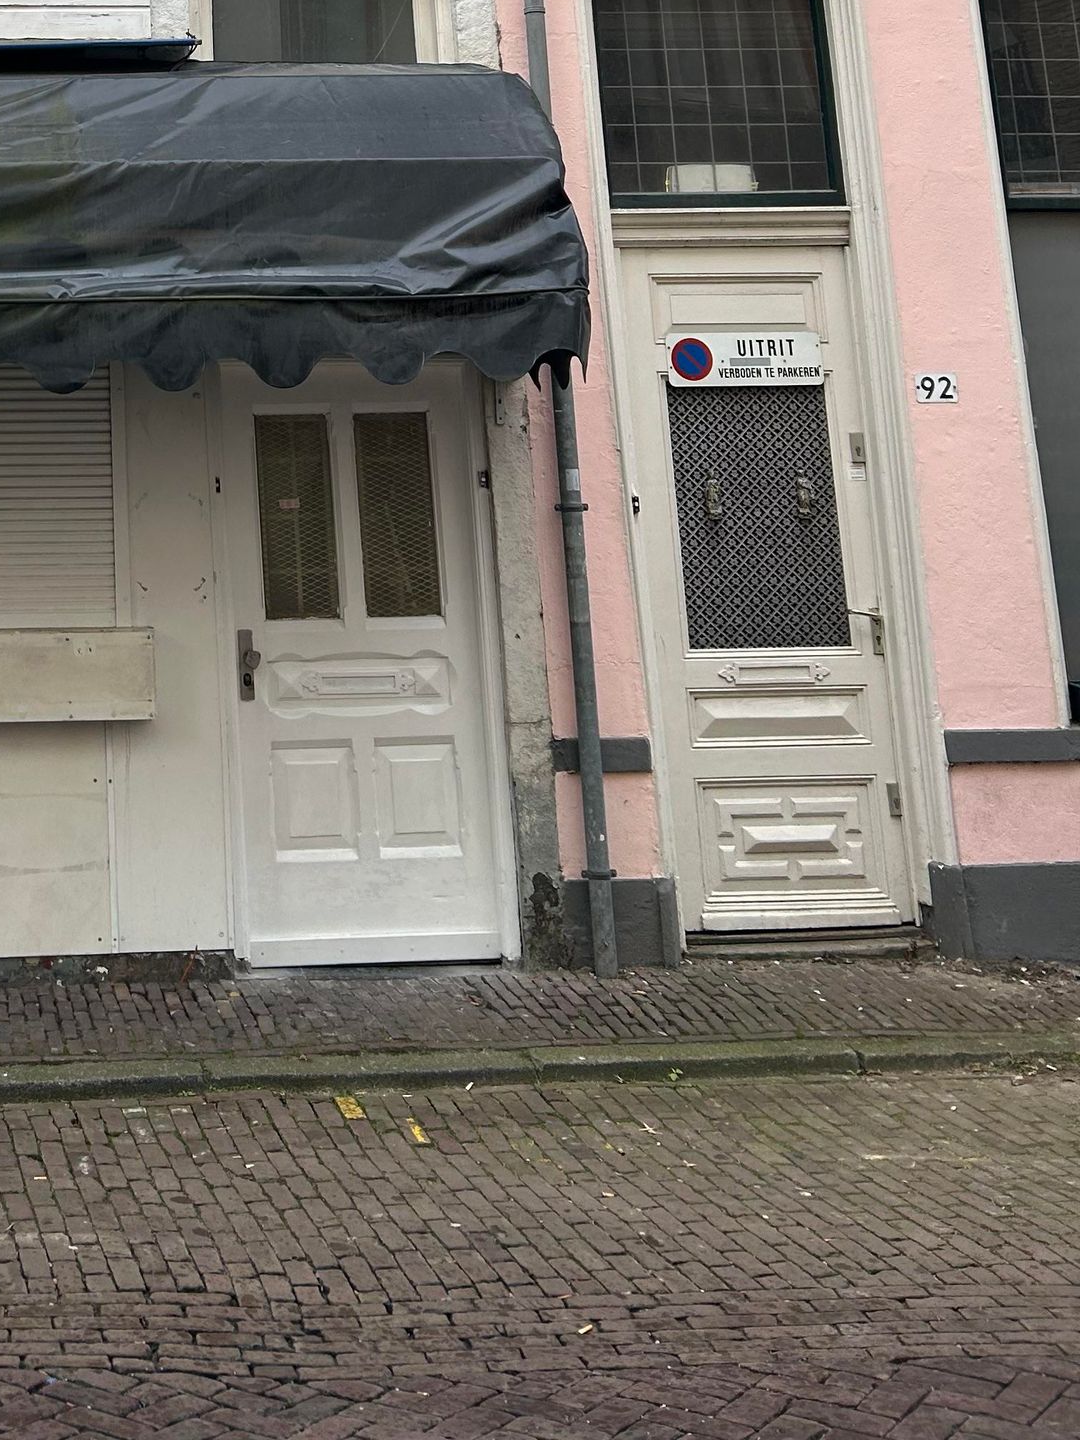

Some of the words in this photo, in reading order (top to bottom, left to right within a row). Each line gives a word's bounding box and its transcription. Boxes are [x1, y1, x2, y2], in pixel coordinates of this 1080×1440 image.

[737, 339, 794, 357] UITRIT
[718, 367, 762, 379] VERBODEN
[764, 367, 775, 378] TE
[777, 366, 820, 378] PARKEREN
[920, 376, 954, 400] 92
